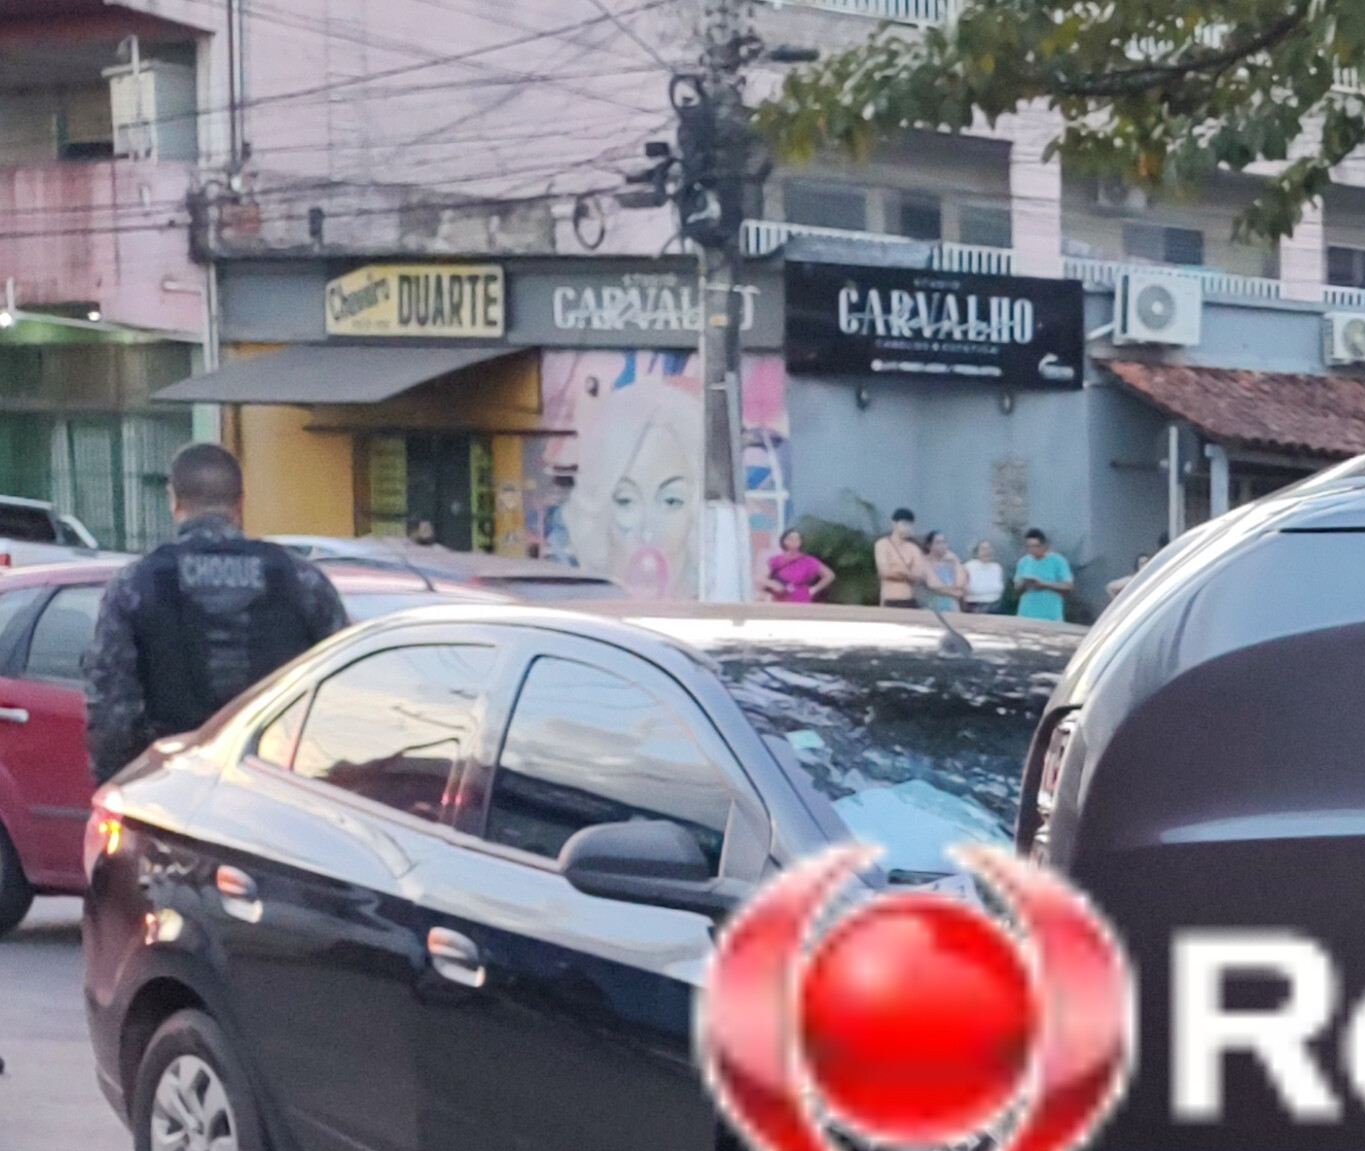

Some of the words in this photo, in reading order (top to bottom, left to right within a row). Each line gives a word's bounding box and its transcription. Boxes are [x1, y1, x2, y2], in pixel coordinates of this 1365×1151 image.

[398, 273, 498, 327] DUARTE
[553, 286, 755, 331] CARVALO
[838, 287, 1034, 344] CARVALHO
[181, 554, 263, 588] CHOQUE
